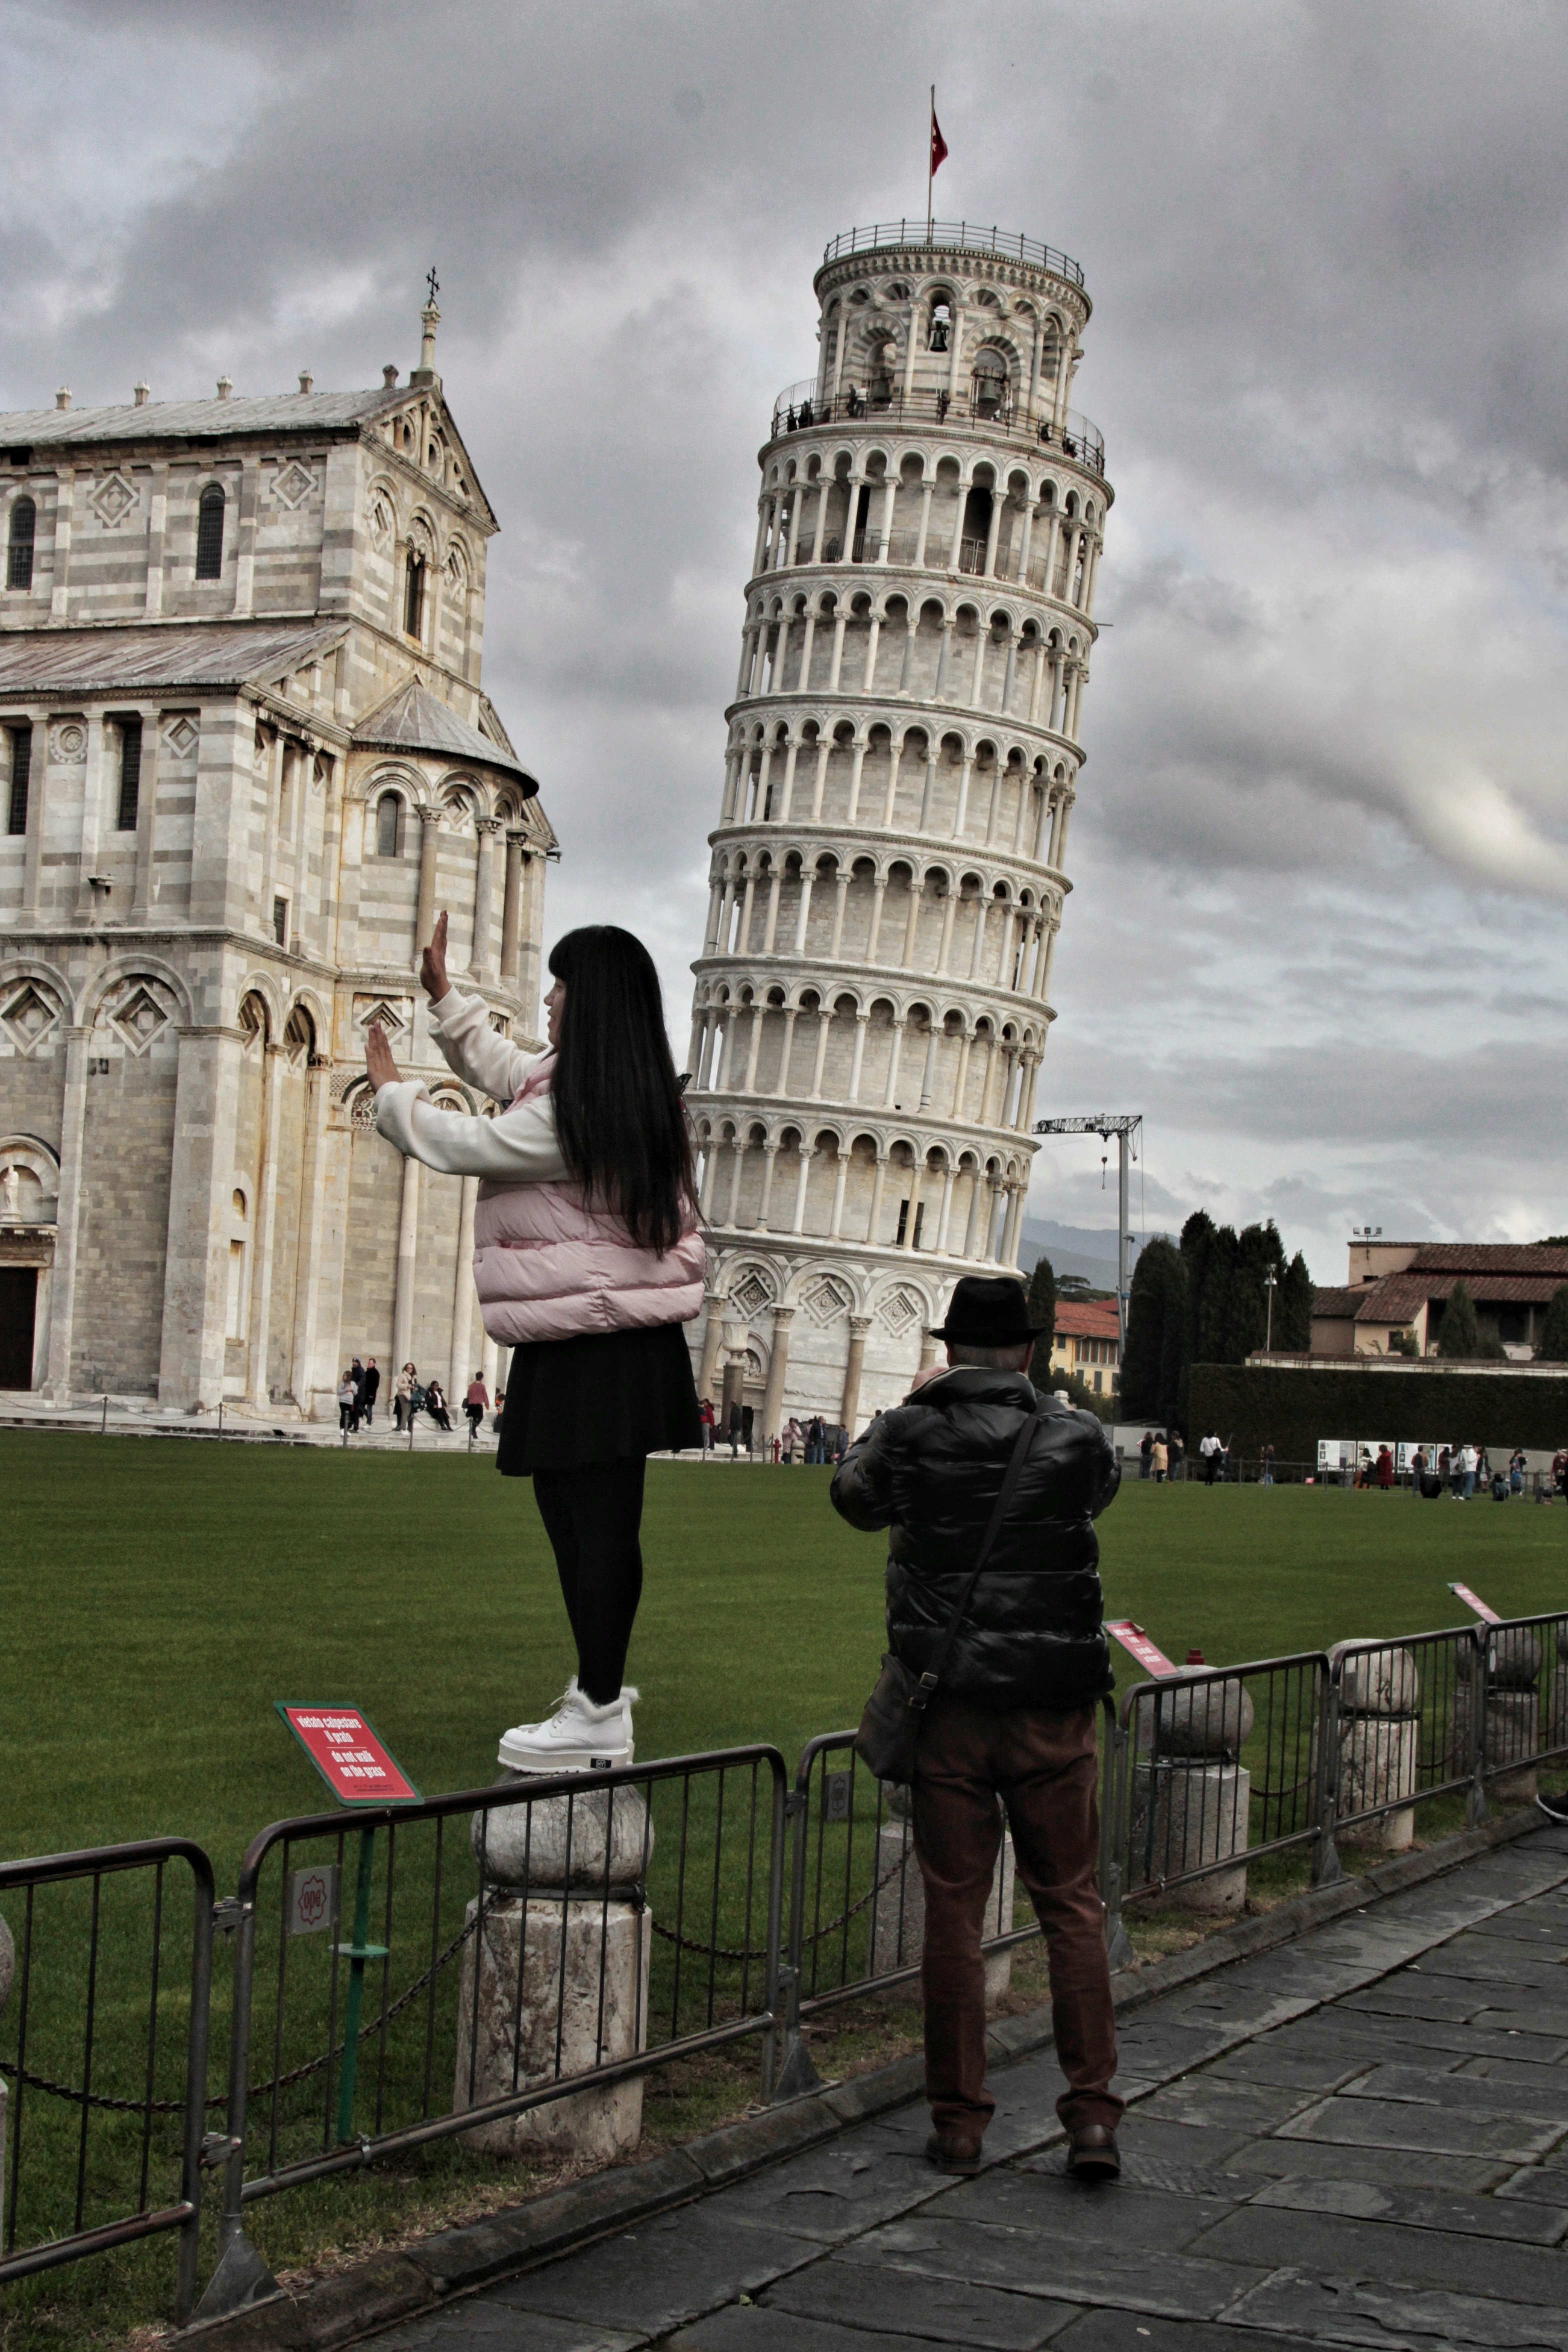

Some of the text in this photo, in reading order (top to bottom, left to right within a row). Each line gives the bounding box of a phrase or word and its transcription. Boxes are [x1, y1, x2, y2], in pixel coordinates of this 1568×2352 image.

[296, 1716, 361, 1730] vietato calpestare
[324, 1730, 354, 1744] il prato
[331, 1750, 375, 1762] do not walk
[340, 1765, 386, 1778] on the grass
